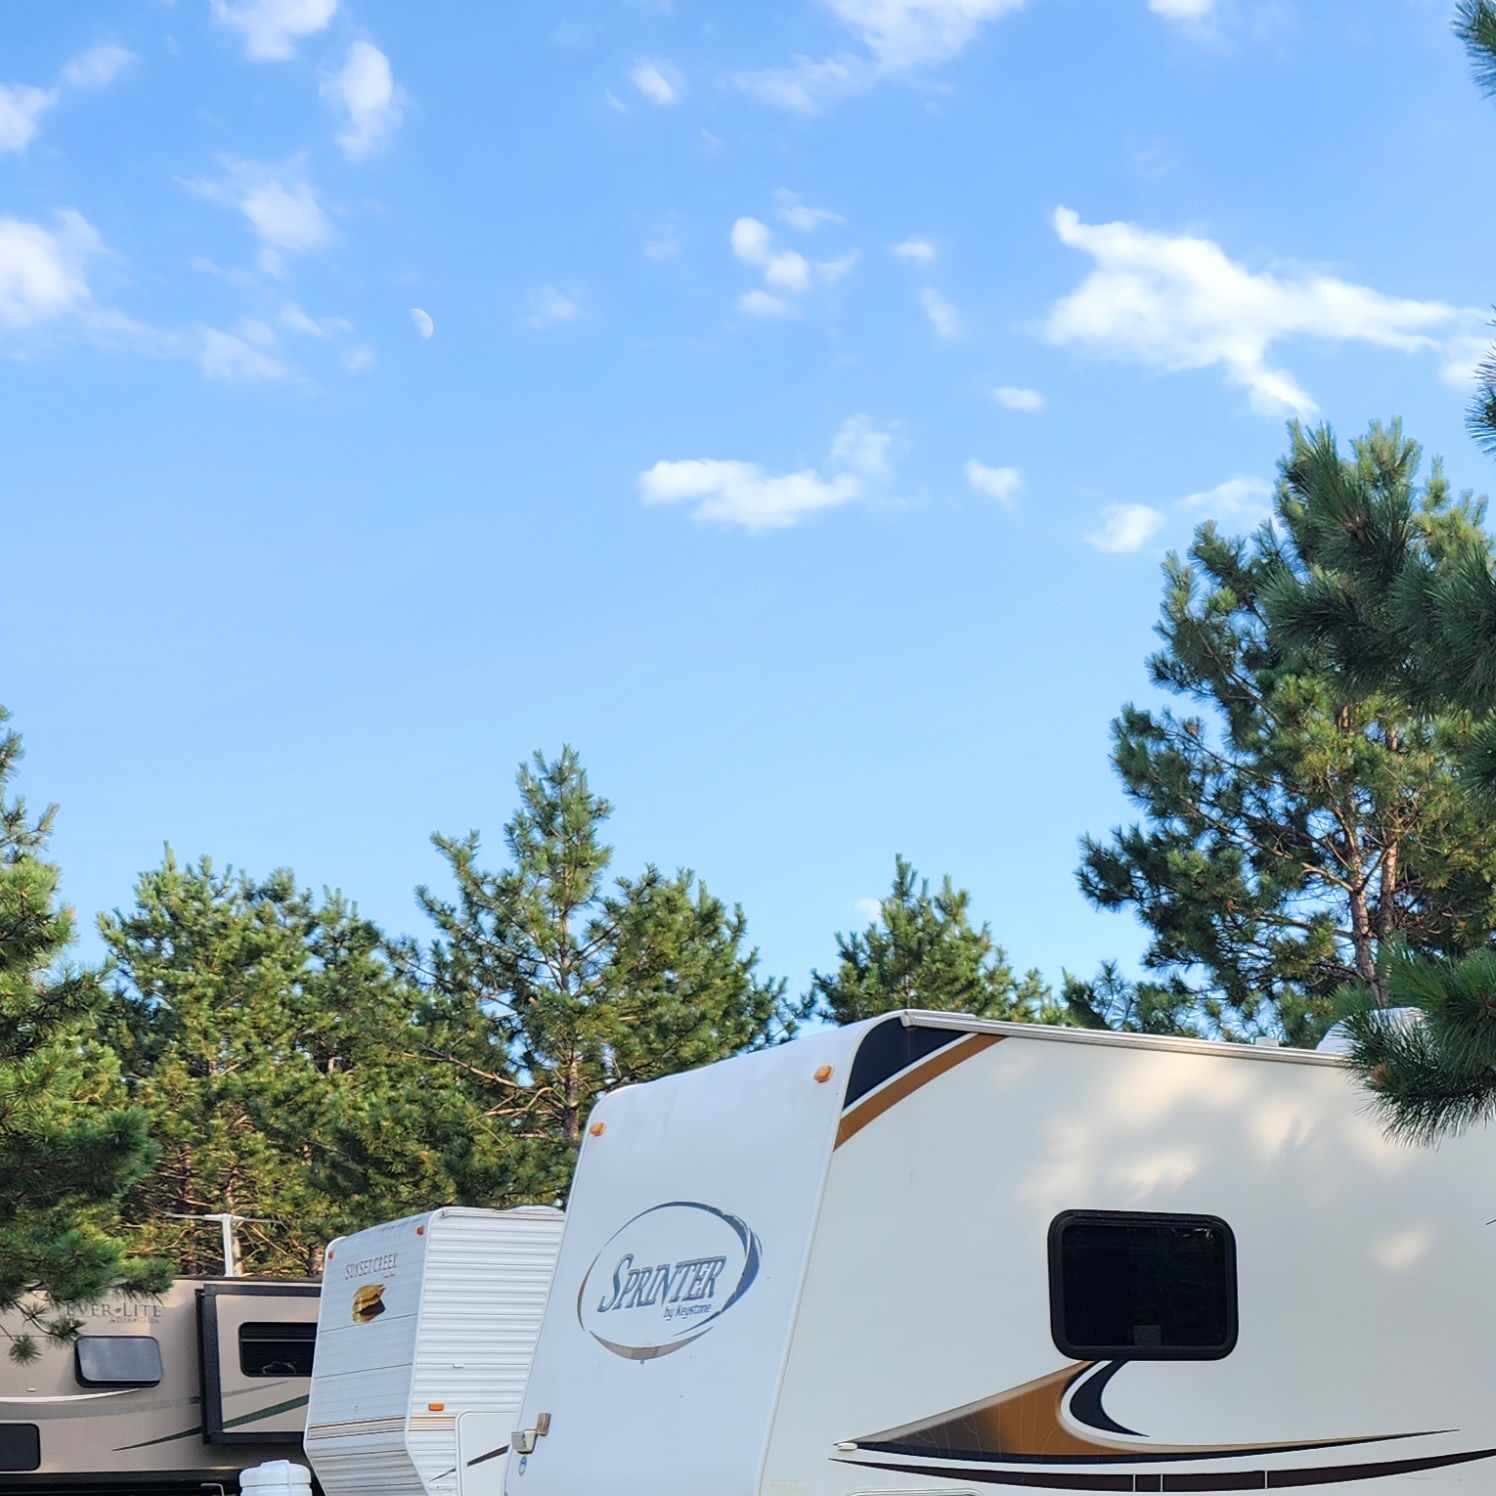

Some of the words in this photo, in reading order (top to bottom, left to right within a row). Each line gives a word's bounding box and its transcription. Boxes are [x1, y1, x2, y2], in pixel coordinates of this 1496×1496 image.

[596, 1253, 726, 1313] SPRINTER
[663, 1305, 674, 1321] by
[675, 1303, 712, 1320] Keystone
